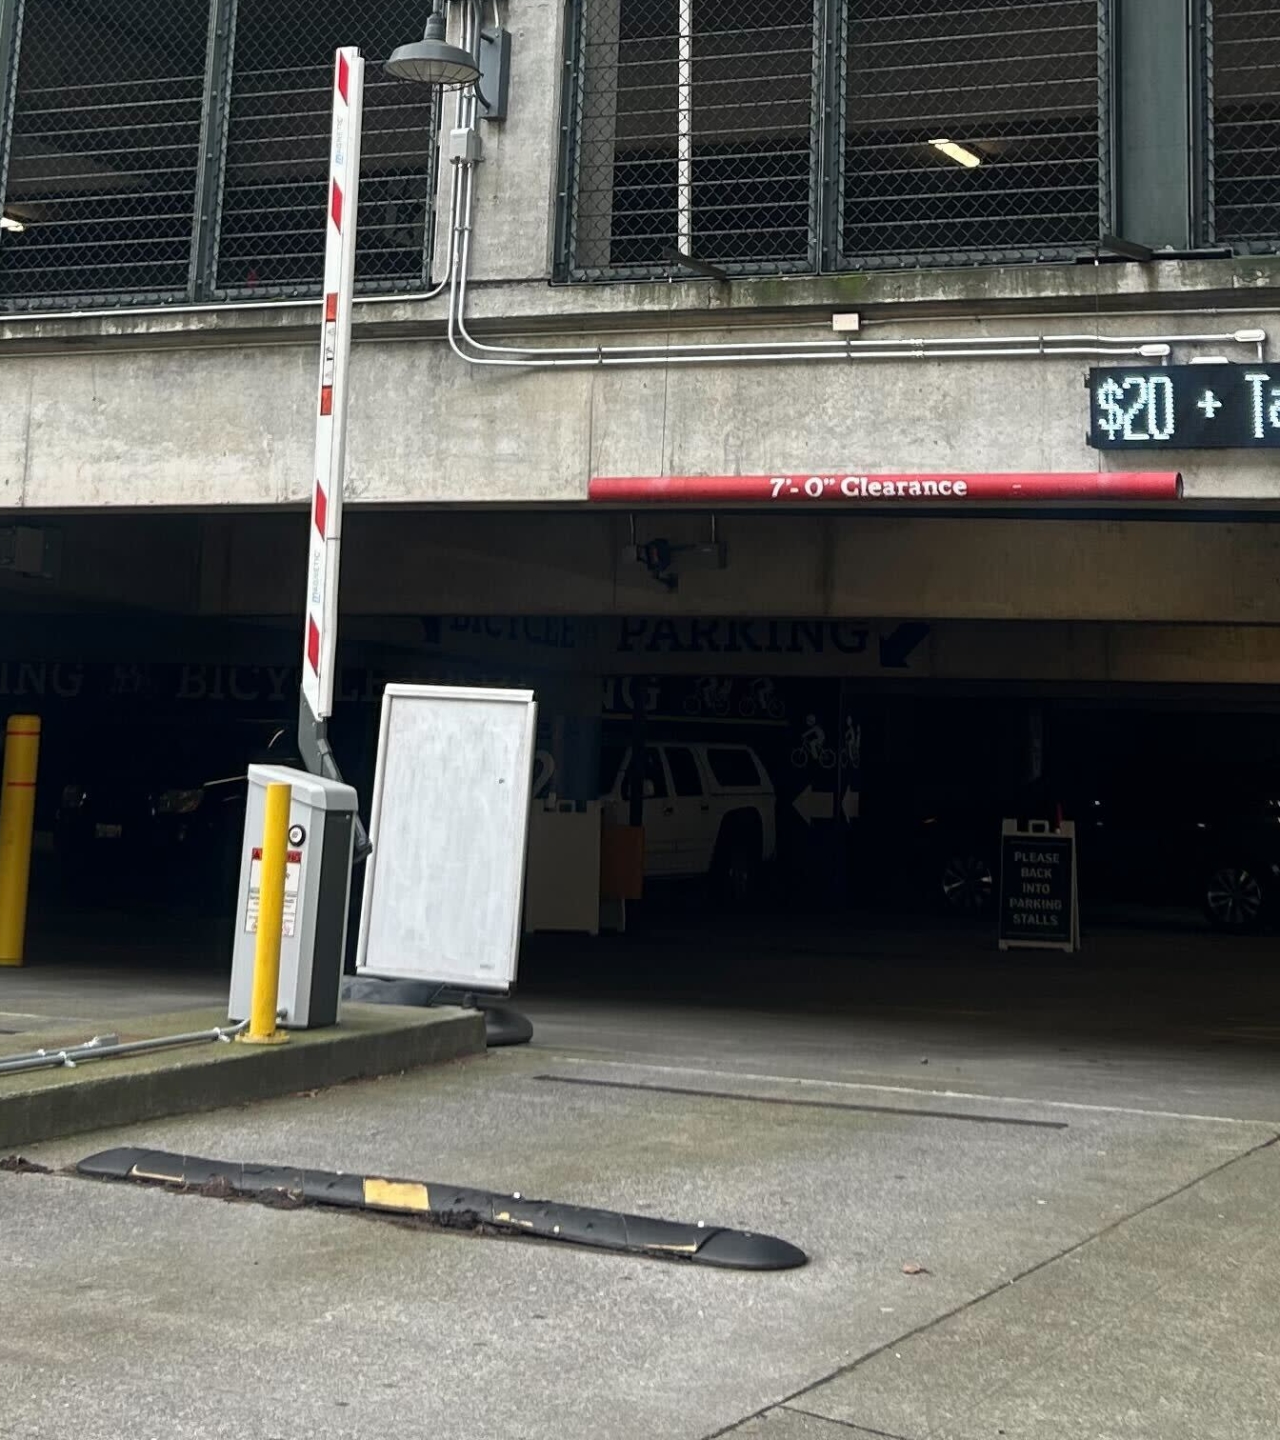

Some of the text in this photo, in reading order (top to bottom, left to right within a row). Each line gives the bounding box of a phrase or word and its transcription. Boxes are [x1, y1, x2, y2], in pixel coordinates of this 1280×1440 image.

[1097, 375, 1175, 441] $20
[1197, 389, 1222, 418] +
[840, 476, 968, 497] Clearance
[616, 616, 870, 654] PARKING
[1013, 851, 1060, 864] PLEASE
[1020, 867, 1053, 879] BACK
[1022, 882, 1051, 895] INTO
[1009, 898, 1063, 911] PARKING
[1012, 913, 1059, 926] STALLS
